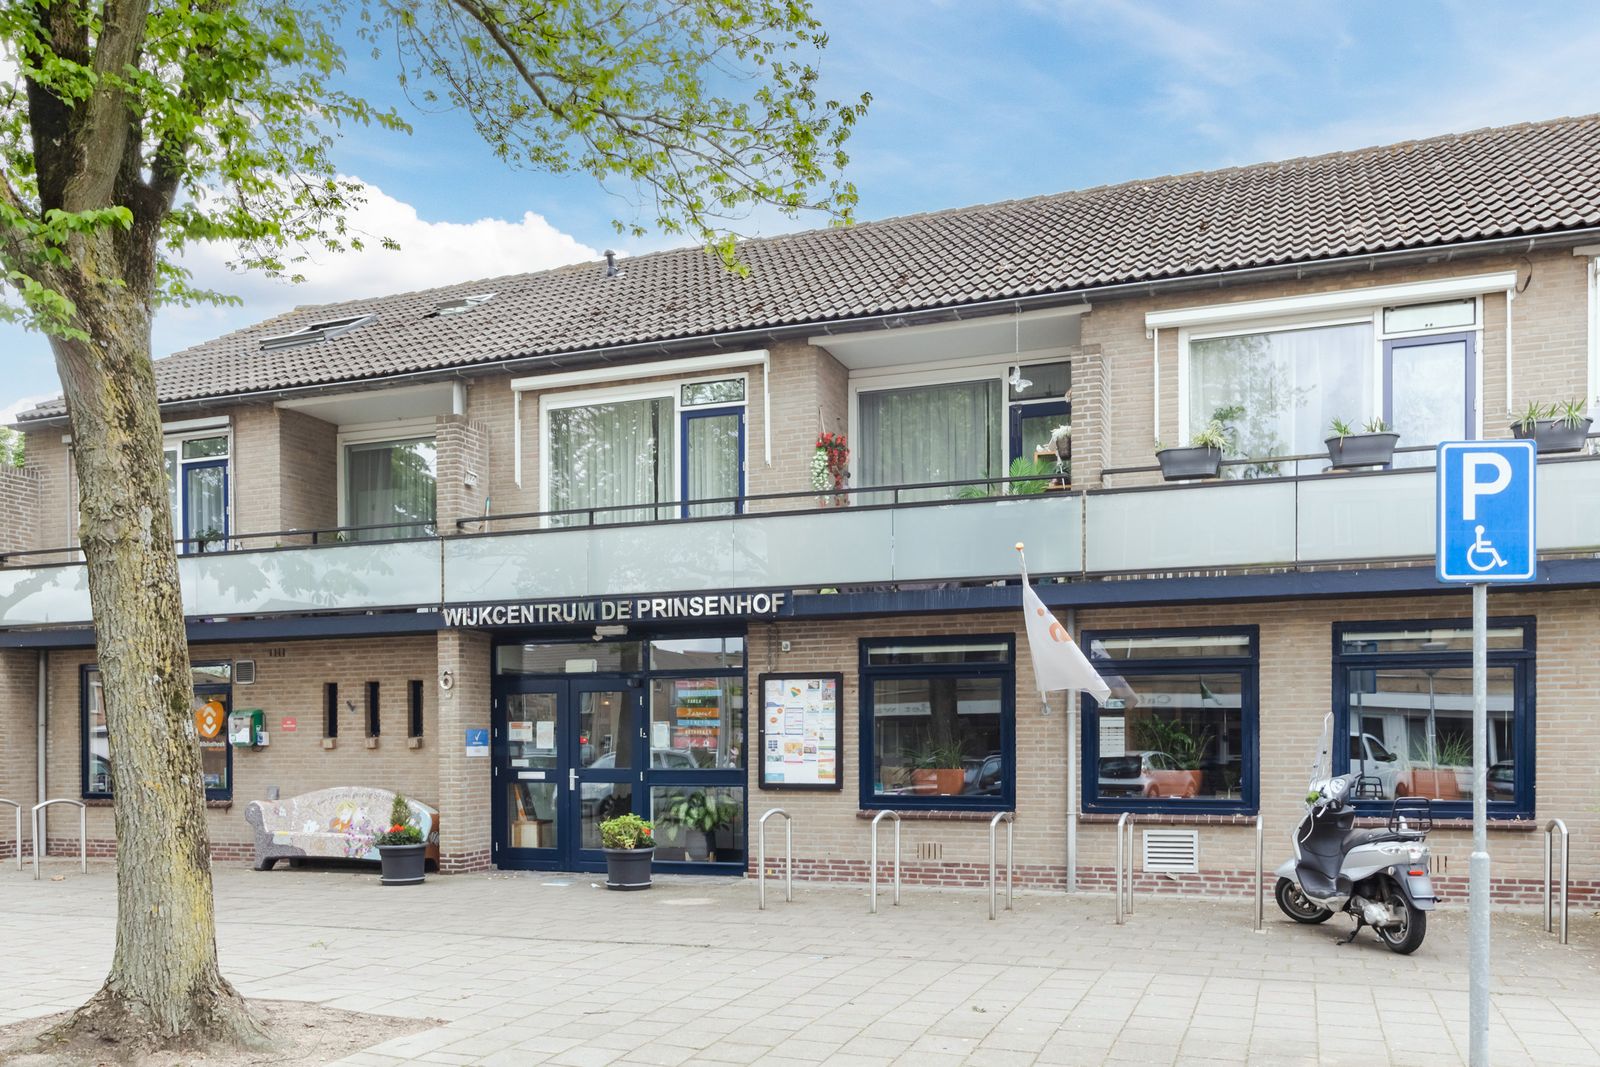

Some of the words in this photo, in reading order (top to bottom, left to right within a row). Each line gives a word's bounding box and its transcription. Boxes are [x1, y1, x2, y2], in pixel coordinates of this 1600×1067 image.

[1462, 452, 1513, 521] P
[443, 602, 595, 627] WIJKCENTRUM
[601, 600, 632, 621] DE
[637, 593, 785, 619] PRINSENHOF
[439, 668, 454, 690] 6
